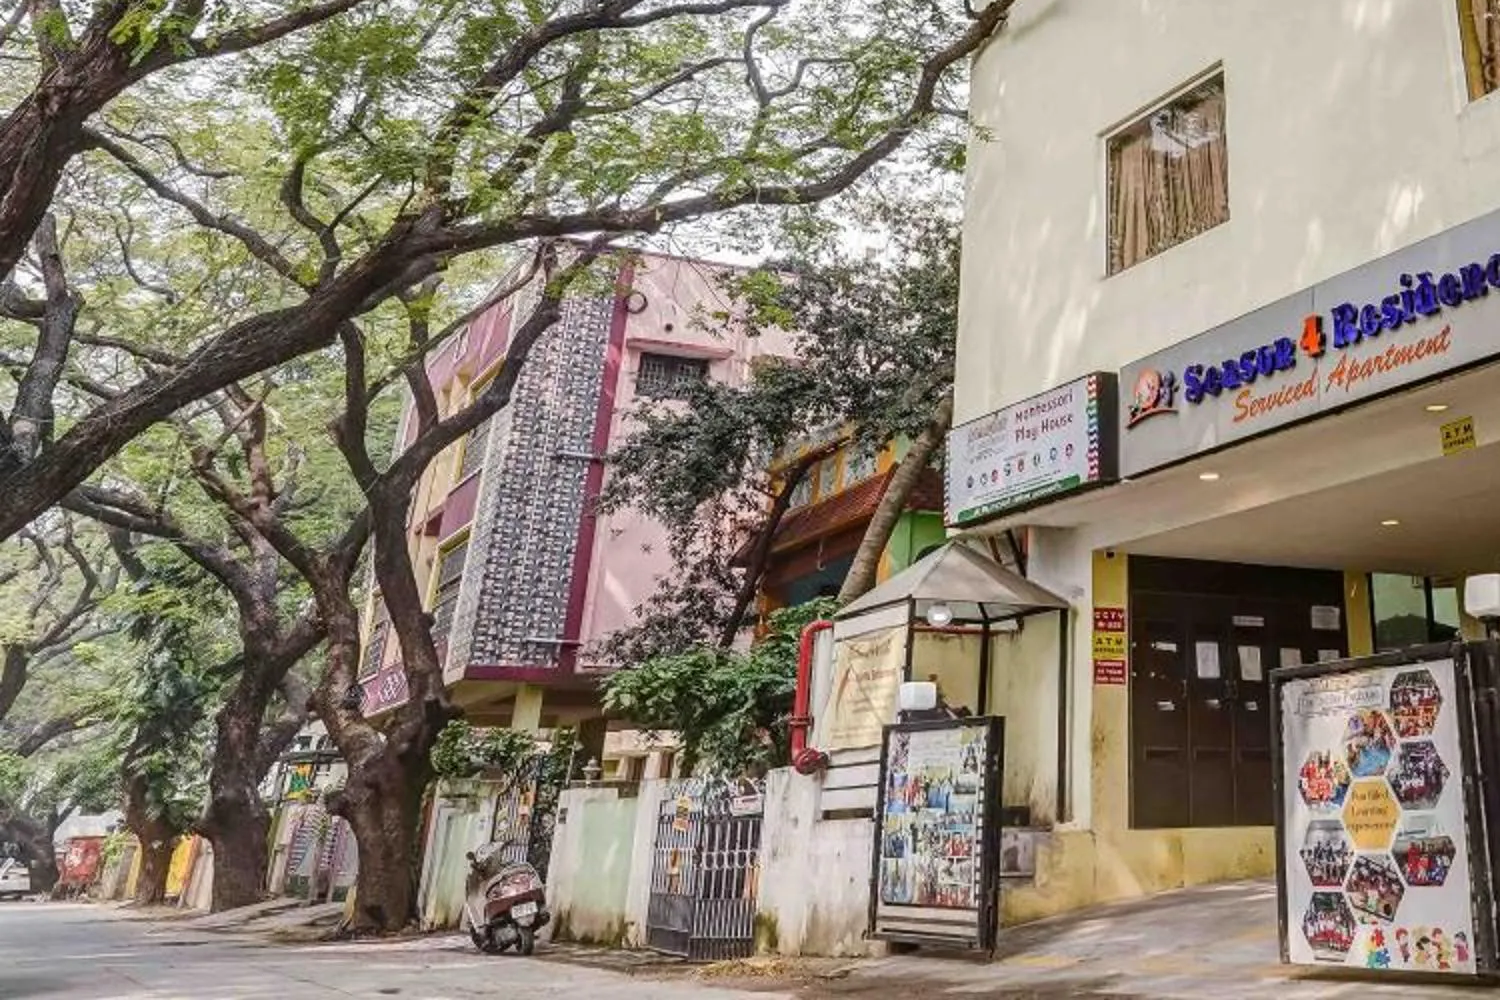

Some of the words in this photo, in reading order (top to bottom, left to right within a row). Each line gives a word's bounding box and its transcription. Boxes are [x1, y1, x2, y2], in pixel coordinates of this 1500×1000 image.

[1184, 337, 1297, 404] Season
[1300, 312, 1326, 358] 4
[1232, 365, 1318, 423] Serviced
[1325, 324, 1452, 392] Apartment
[1041, 413, 1074, 434] House
